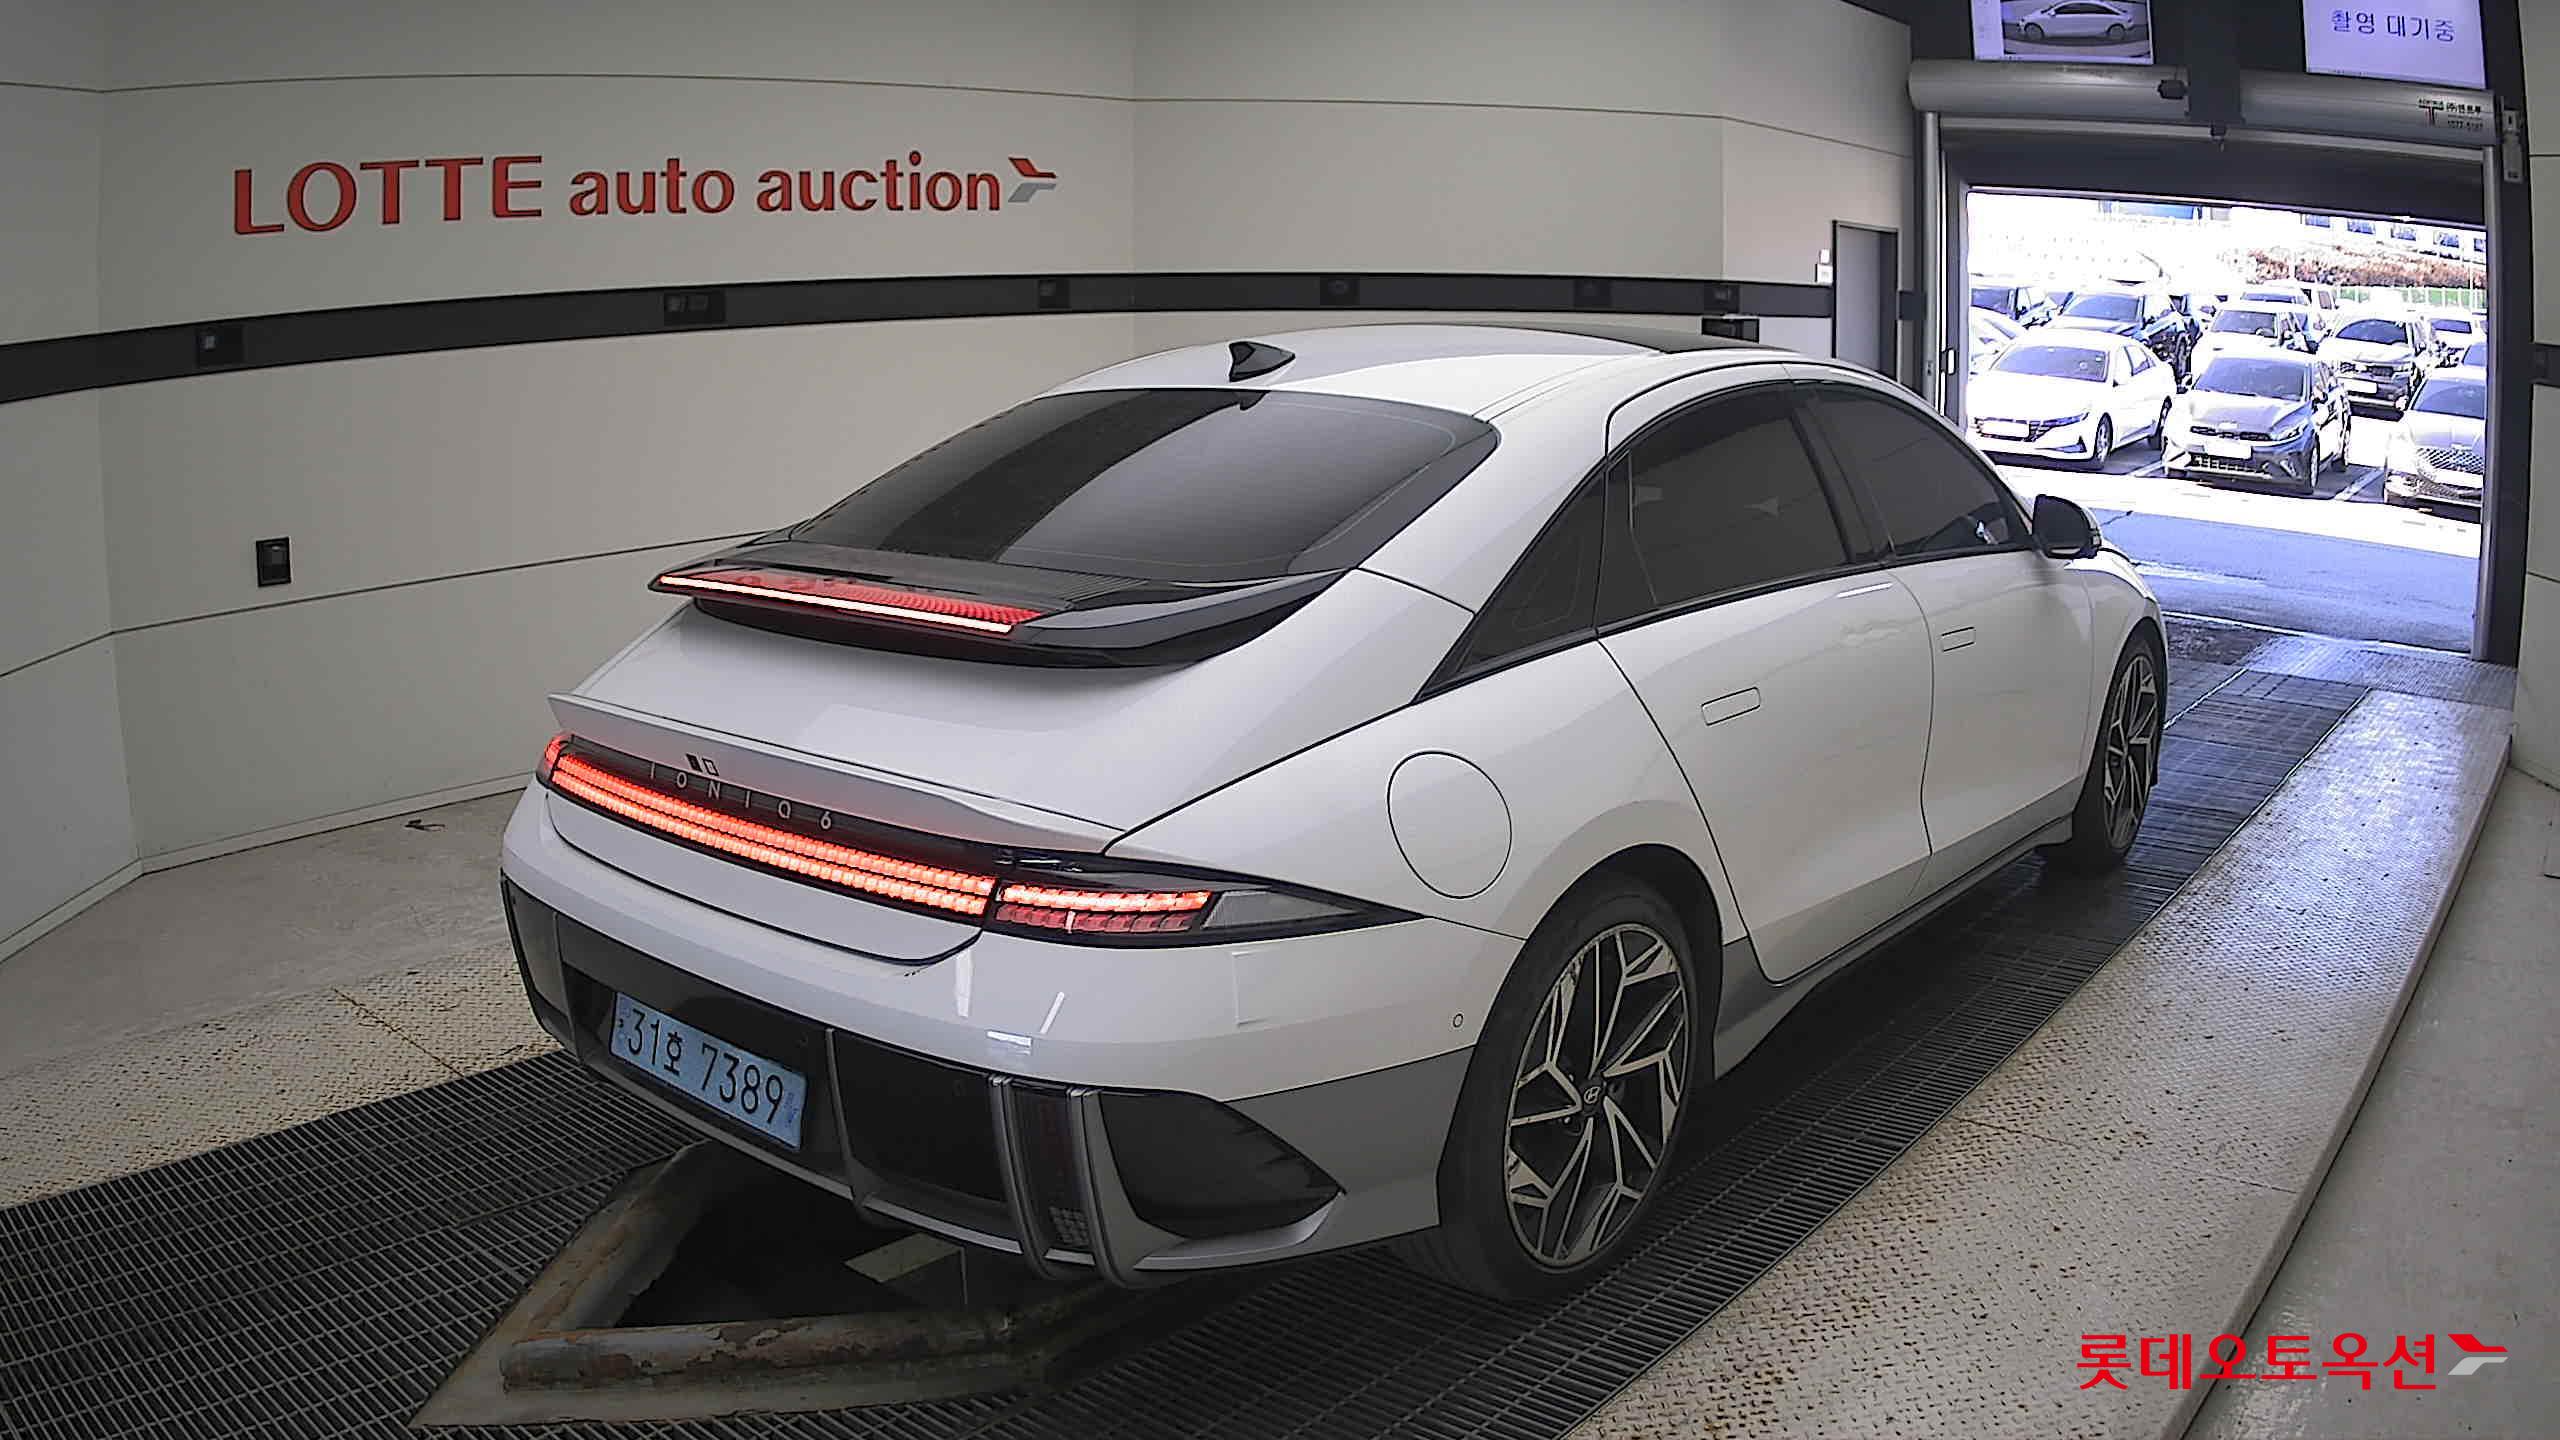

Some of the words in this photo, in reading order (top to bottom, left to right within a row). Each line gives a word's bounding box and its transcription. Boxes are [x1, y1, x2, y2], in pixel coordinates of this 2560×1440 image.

[2332, 10, 2375, 34] 촬영
[2387, 15, 2454, 42] 대기중
[234, 155, 542, 235] LOTTE
[569, 157, 735, 216] auto
[756, 150, 1000, 212] auction
[650, 763, 793, 819] IONIQ
[819, 811, 832, 831] 6
[627, 1009, 682, 1076] 31호
[701, 1042, 783, 1124] 7389
